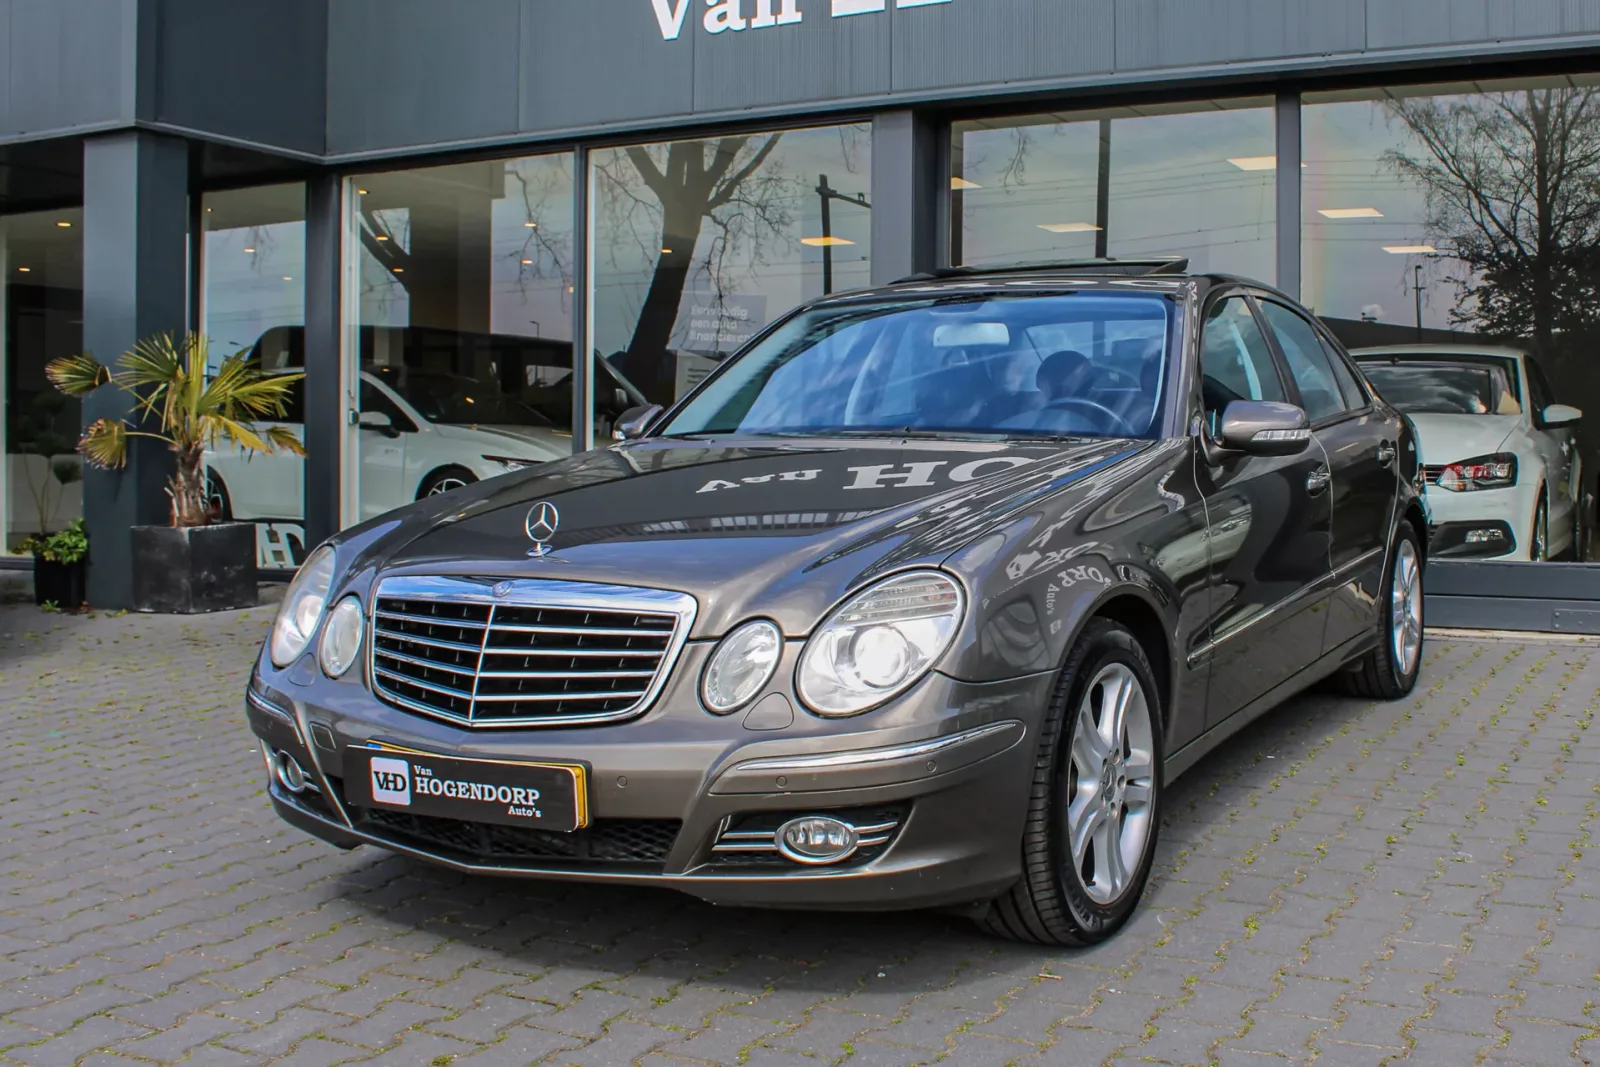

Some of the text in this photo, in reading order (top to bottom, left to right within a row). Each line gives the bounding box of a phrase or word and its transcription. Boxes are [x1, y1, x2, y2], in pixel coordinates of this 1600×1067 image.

[649, 0, 802, 41] Van
[414, 765, 432, 776] Van
[373, 771, 406, 792] VHD
[415, 777, 540, 804] HOGENDORP
[508, 806, 541, 818] Auto's
